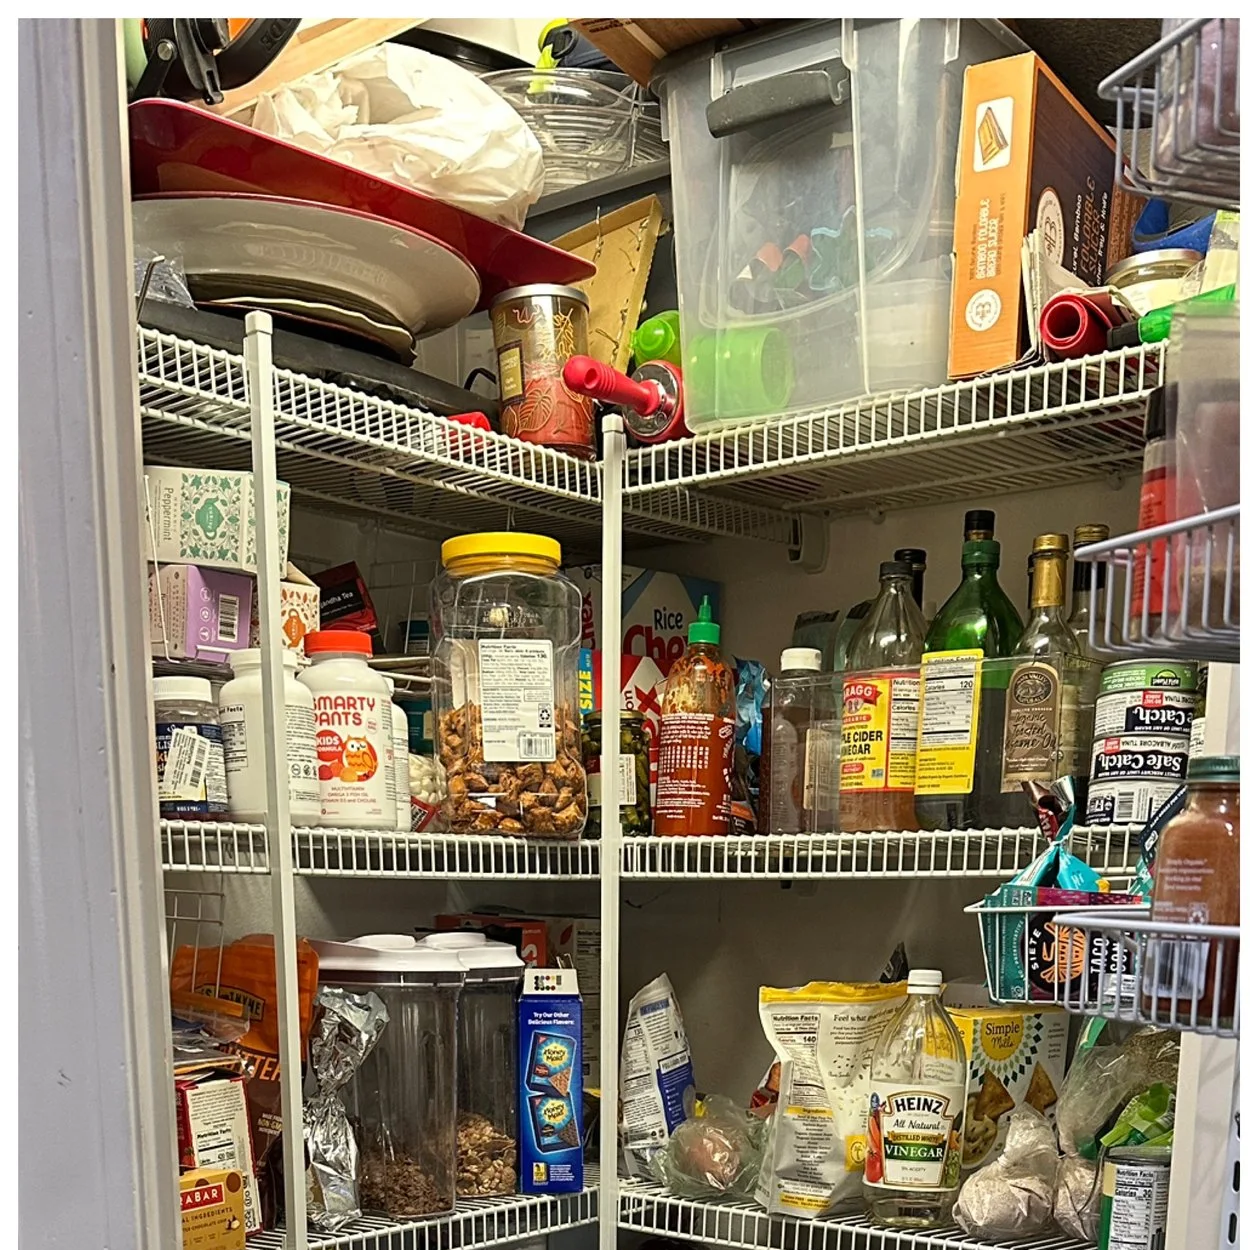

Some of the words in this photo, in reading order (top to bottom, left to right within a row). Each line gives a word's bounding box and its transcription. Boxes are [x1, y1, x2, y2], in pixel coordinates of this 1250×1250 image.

[1080, 176, 1095, 273] FOLDABLE
[163, 487, 173, 541] Peppermint
[654, 608, 683, 630] Rice
[623, 626, 687, 658] Che
[579, 670, 592, 710] SIZE
[312, 696, 375, 712] SMARTY
[1134, 708, 1186, 725] Catch
[317, 735, 340, 746] KIDS
[853, 731, 883, 742] CIDER
[1121, 740, 1138, 748] TUNA
[1139, 740, 1171, 748] ALBACORE
[1099, 753, 1144, 769] Catch
[1147, 753, 1183, 771] Safe
[1030, 929, 1042, 970] SIETE
[985, 1021, 1020, 1038] Simple
[989, 1035, 1015, 1049] Mills
[543, 1048, 566, 1057] Honey
[543, 1104, 566, 1116] Honey
[896, 1097, 943, 1114] HEINZ
[893, 1120, 906, 1128] All
[908, 1119, 940, 1130] Natural
[885, 1144, 943, 1157] VINEGAR
[192, 1208, 233, 1221] INGREDIENTS
